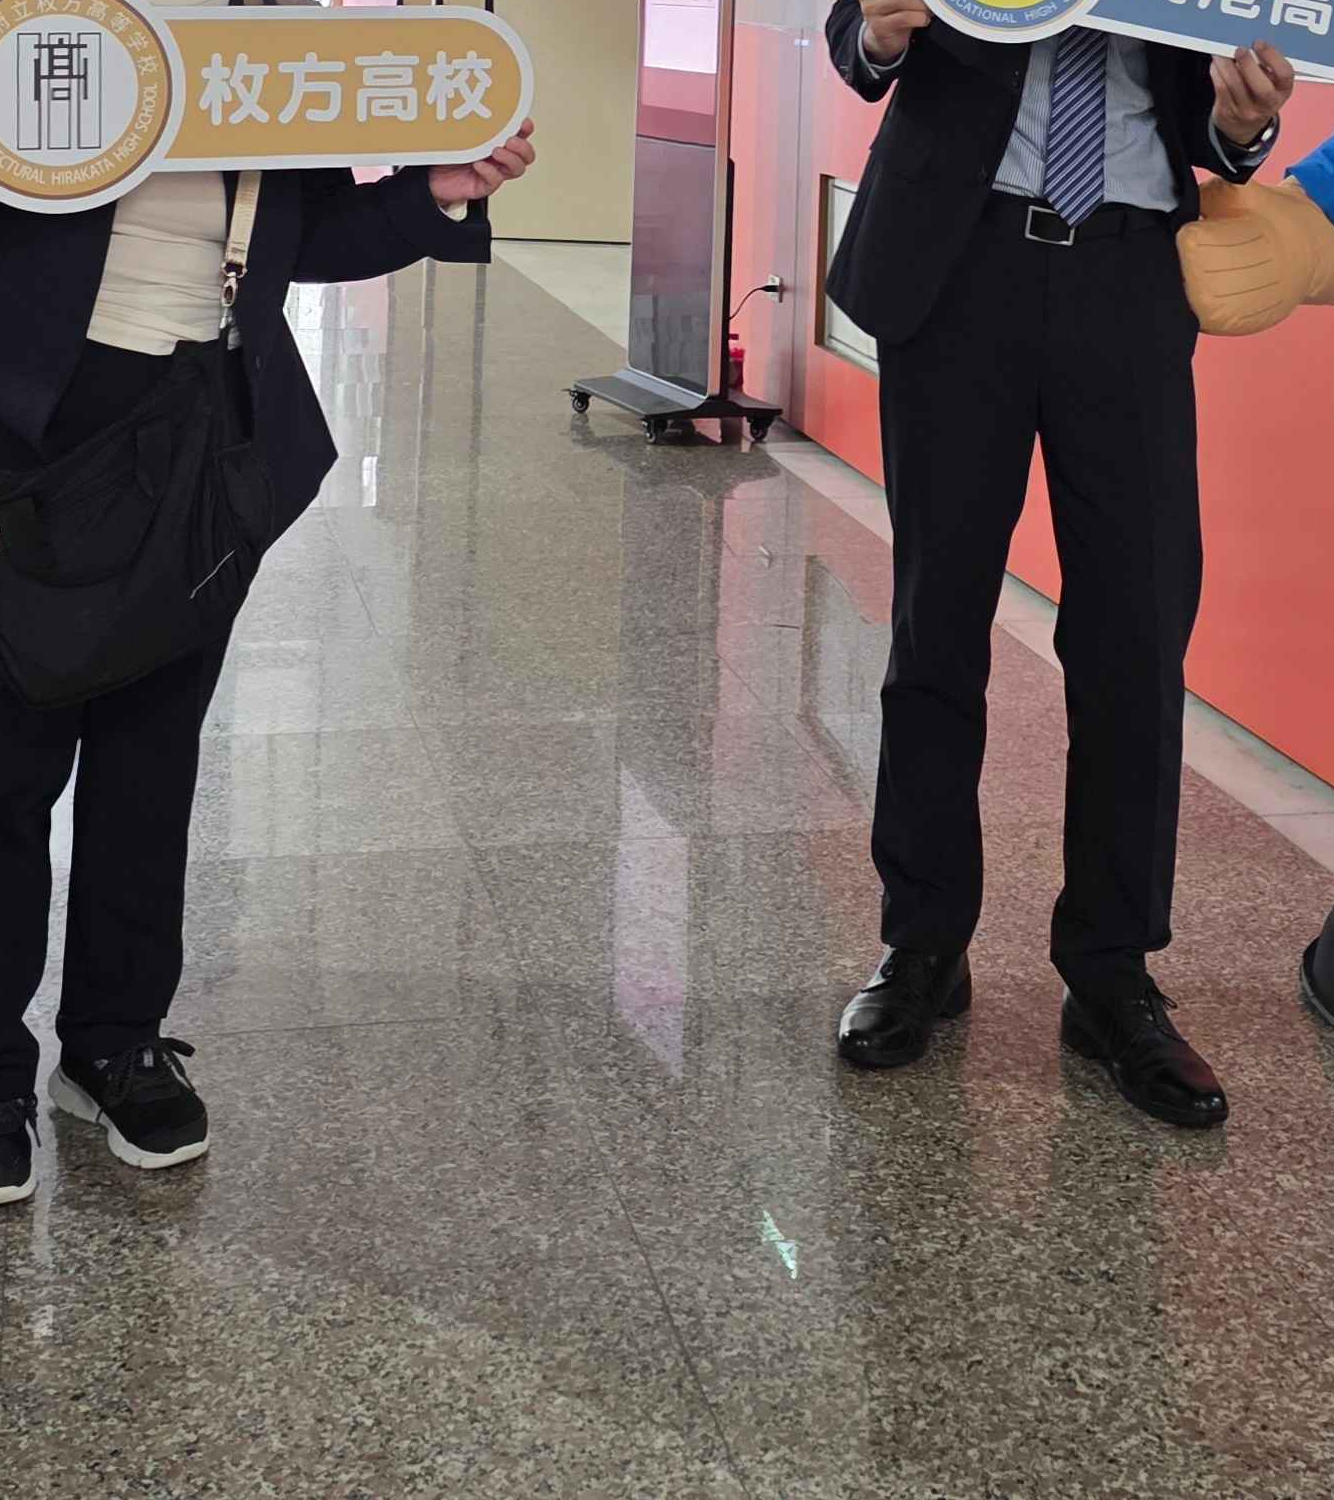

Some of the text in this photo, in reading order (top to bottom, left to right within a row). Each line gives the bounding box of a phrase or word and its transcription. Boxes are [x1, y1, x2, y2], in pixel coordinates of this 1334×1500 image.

[1024, 2, 1057, 22] HIGH
[199, 51, 494, 126] 枚方高校
[51, 157, 116, 185] HIRAKATA
[114, 132, 141, 163] HIGH
[134, 83, 158, 133] SCHOOL
